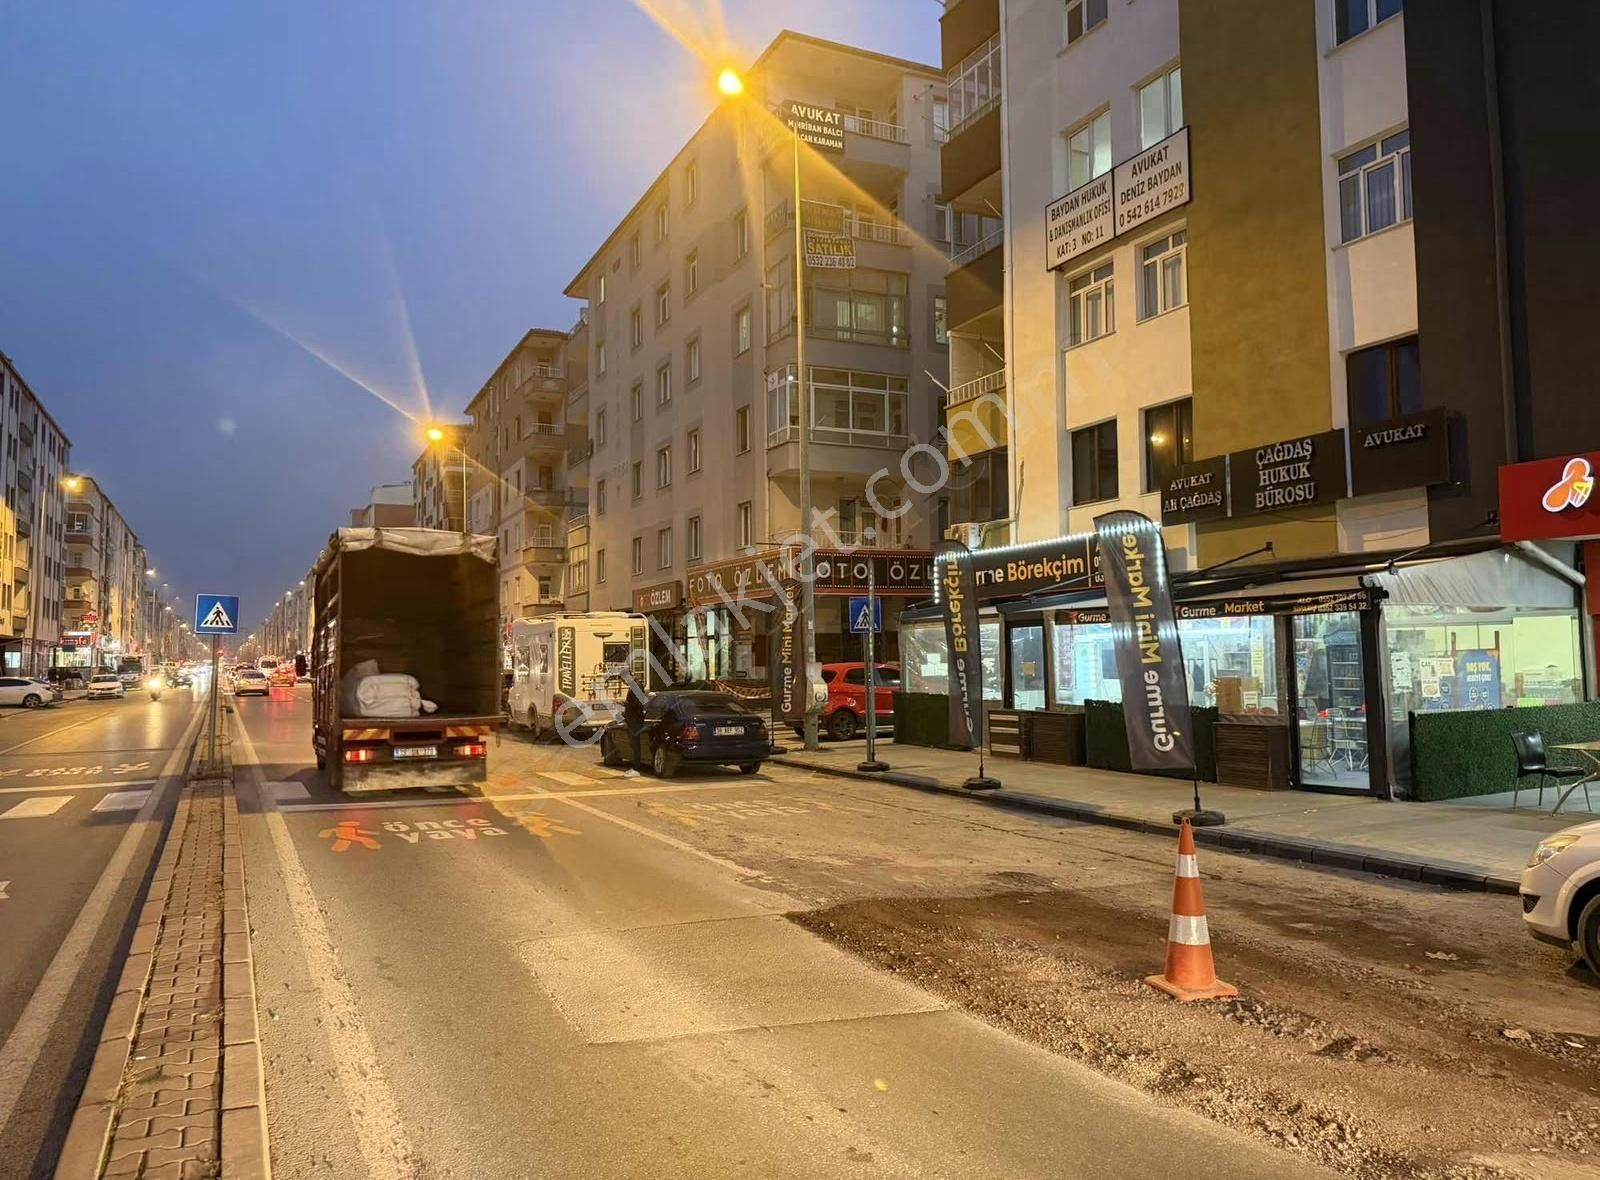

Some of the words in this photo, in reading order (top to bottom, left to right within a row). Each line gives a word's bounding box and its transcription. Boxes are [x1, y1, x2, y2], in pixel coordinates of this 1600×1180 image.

[790, 104, 841, 125] AVUKAT
[1131, 146, 1169, 178] AVUKAT
[1120, 179, 1146, 206] DENİZ
[1147, 161, 1182, 190] BAYDAN
[1051, 194, 1080, 221] BAYDAN
[1081, 180, 1107, 205] HUKUK
[1094, 198, 1111, 220] OFİSİ
[1119, 213, 1124, 227] 0
[1127, 205, 1143, 225] 542
[1144, 199, 1160, 218] 614
[808, 242, 852, 256] SATILIK
[1056, 241, 1072, 258] KAT:
[1072, 239, 1077, 251] 3
[1081, 230, 1094, 246] NO:
[1095, 225, 1104, 238] 11
[1364, 424, 1425, 447] AVUKAT
[1256, 439, 1312, 469] ÇAĞDAŞ
[1170, 473, 1212, 490] AVUKAT
[1259, 462, 1311, 486] HUKUK
[1180, 491, 1222, 511] ÇAĞDAŞ
[1256, 483, 1315, 508] BÜROSU
[689, 574, 722, 592] FOTO
[734, 562, 787, 587] ÖZLEM
[816, 563, 868, 579] OTO
[1007, 554, 1084, 582] Börekçim
[1078, 613, 1107, 622] Gurme
[1181, 606, 1216, 617] Gurme
[1224, 601, 1264, 613] Market
[782, 636, 792, 664] Mini
[781, 667, 792, 712] Gurme
